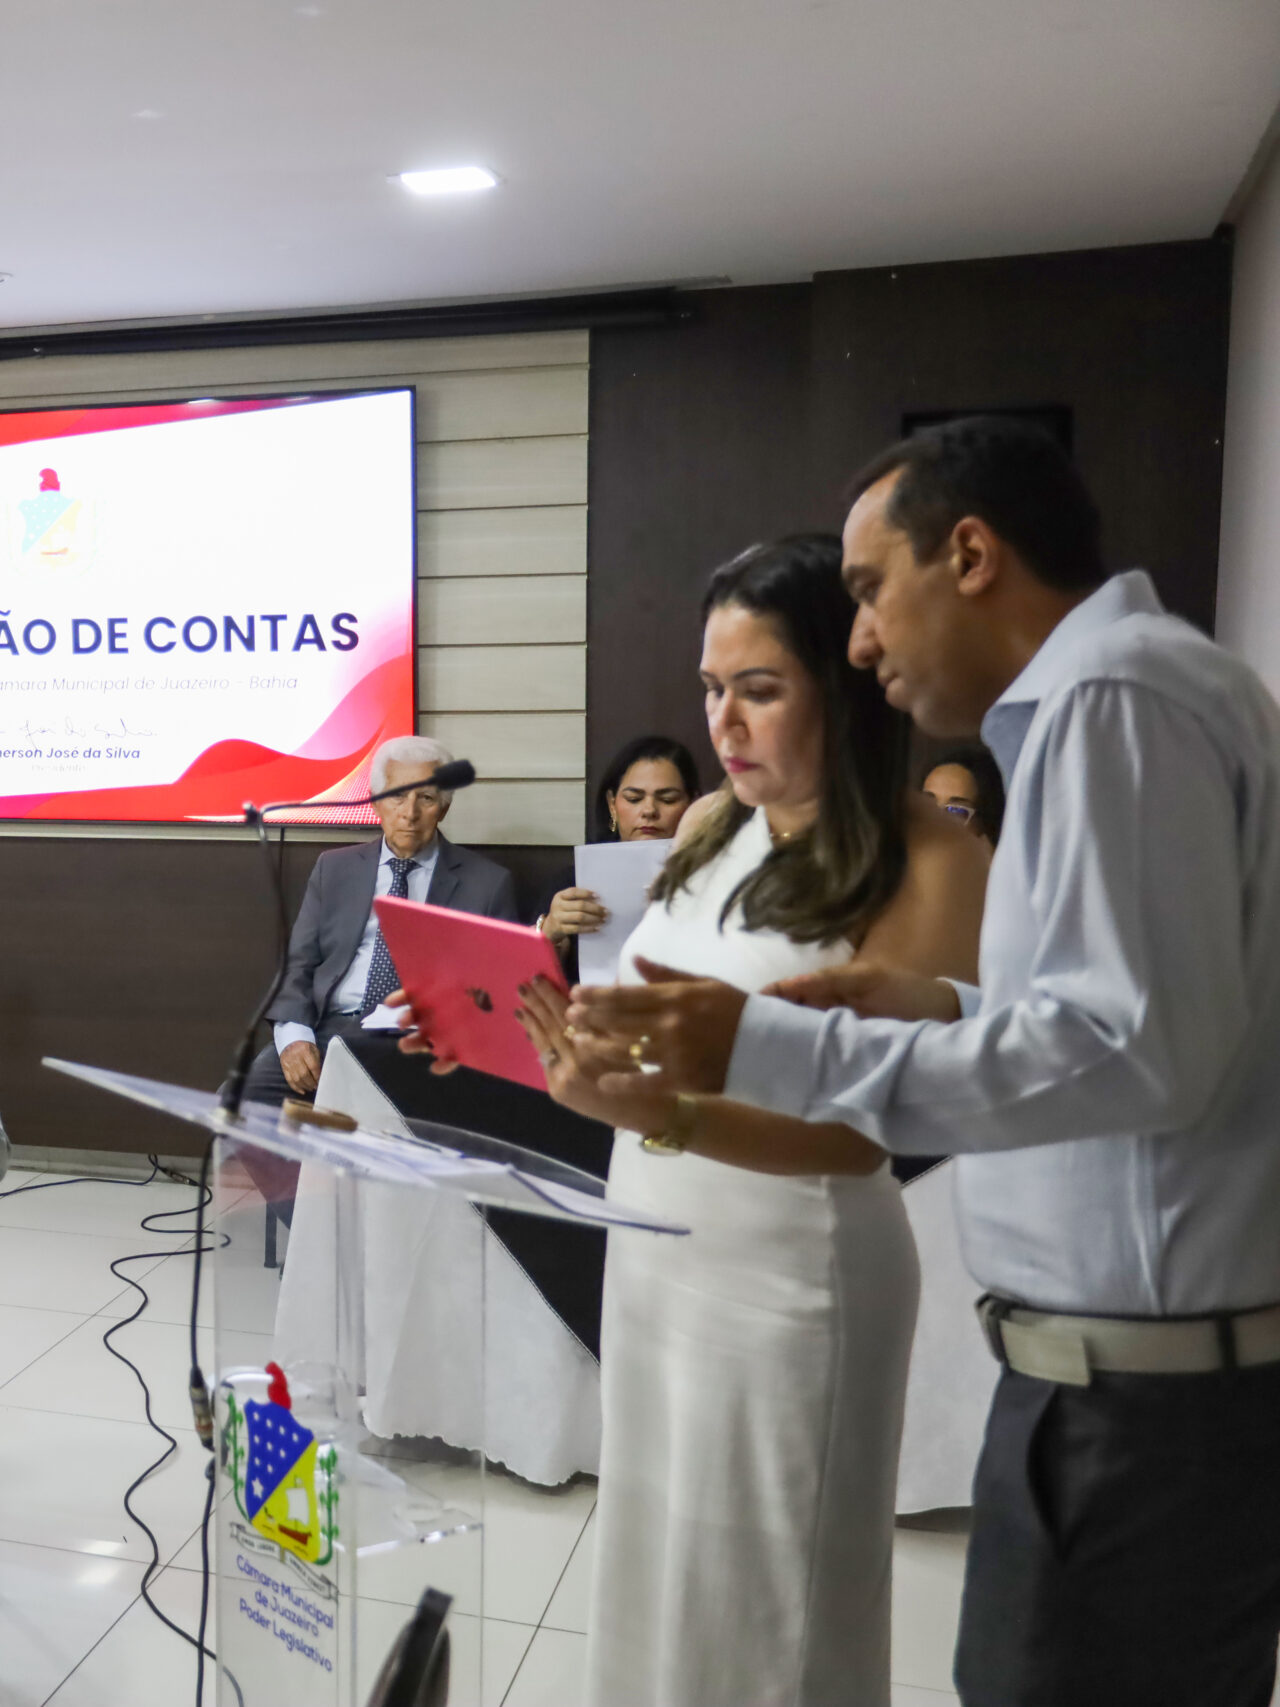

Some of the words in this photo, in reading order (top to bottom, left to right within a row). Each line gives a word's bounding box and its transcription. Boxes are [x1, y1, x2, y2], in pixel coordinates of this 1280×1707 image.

[71, 617, 129, 655] DE
[143, 612, 360, 654] CONTAS
[52, 675, 128, 693] Municipal
[135, 675, 155, 690] de
[160, 676, 230, 691] Juazeiro
[249, 674, 297, 690] Bahia
[46, 747, 79, 759] José
[83, 747, 101, 759] da
[106, 747, 140, 759] Silva
[255, 1590, 268, 1608] de
[271, 1595, 318, 1637] Juazeiro
[281, 1581, 333, 1629] Municipal
[240, 1597, 270, 1629] Poder
[273, 1619, 332, 1672] Legislativo
